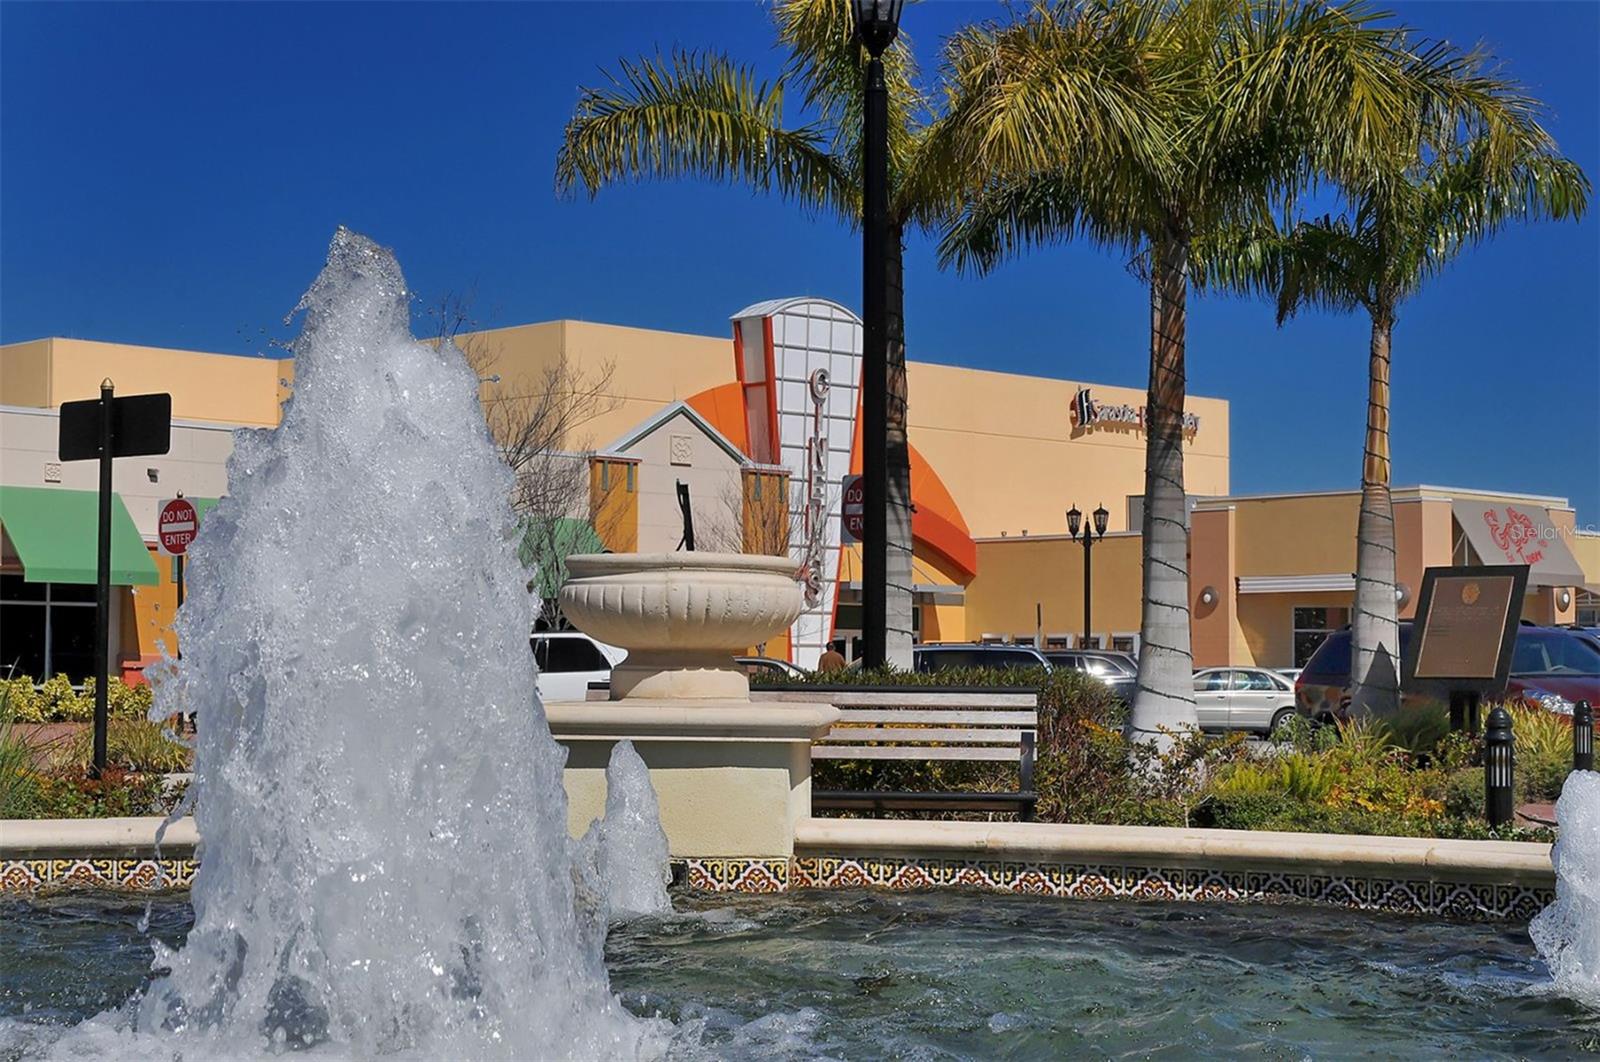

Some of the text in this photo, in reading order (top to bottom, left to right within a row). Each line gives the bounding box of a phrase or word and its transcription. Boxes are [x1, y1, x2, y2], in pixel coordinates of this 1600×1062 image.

[847, 489, 863, 502] DO
[163, 509, 193, 522] DO NOT
[165, 533, 191, 545] ENTER
